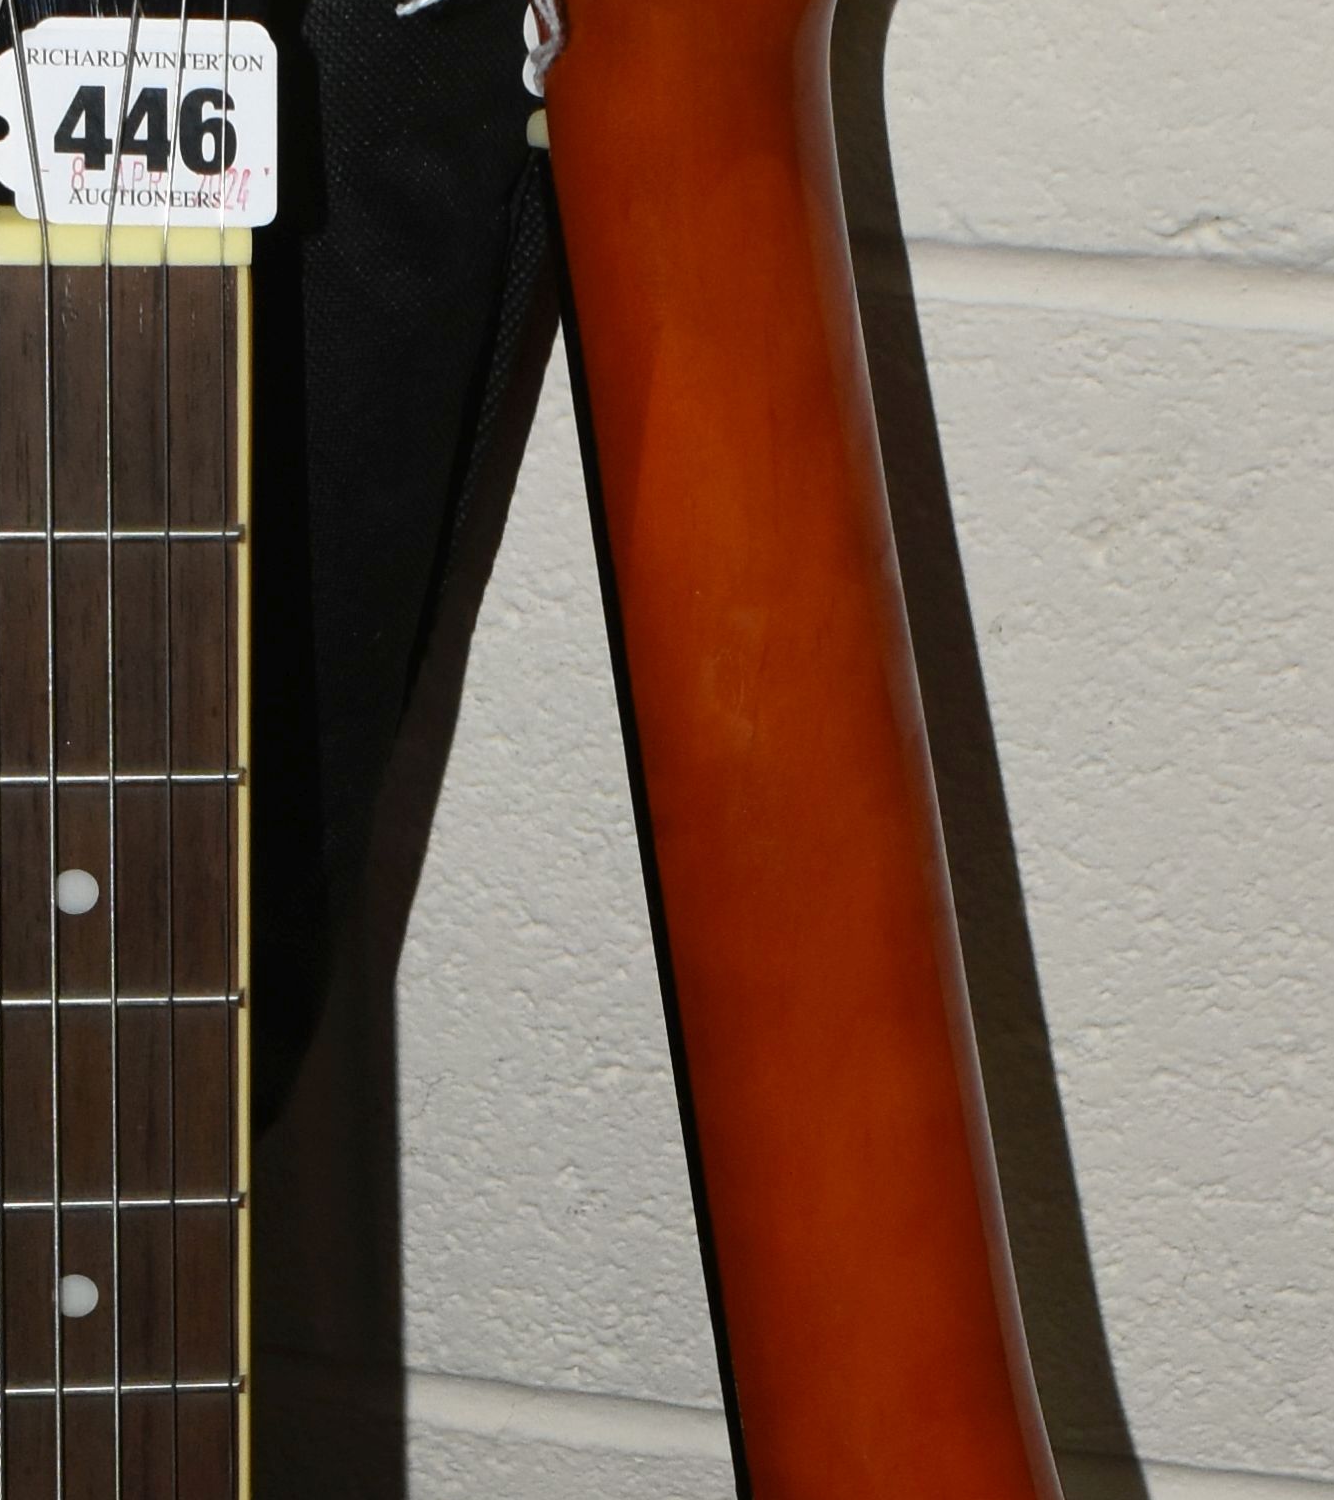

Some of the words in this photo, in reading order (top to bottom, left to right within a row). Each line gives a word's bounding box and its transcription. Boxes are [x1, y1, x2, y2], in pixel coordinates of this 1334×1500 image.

[26, 47, 127, 68] RICHARD
[132, 50, 264, 72] WINTERTON
[54, 85, 237, 176] 446
[68, 187, 223, 209] AUCTIONEERS
